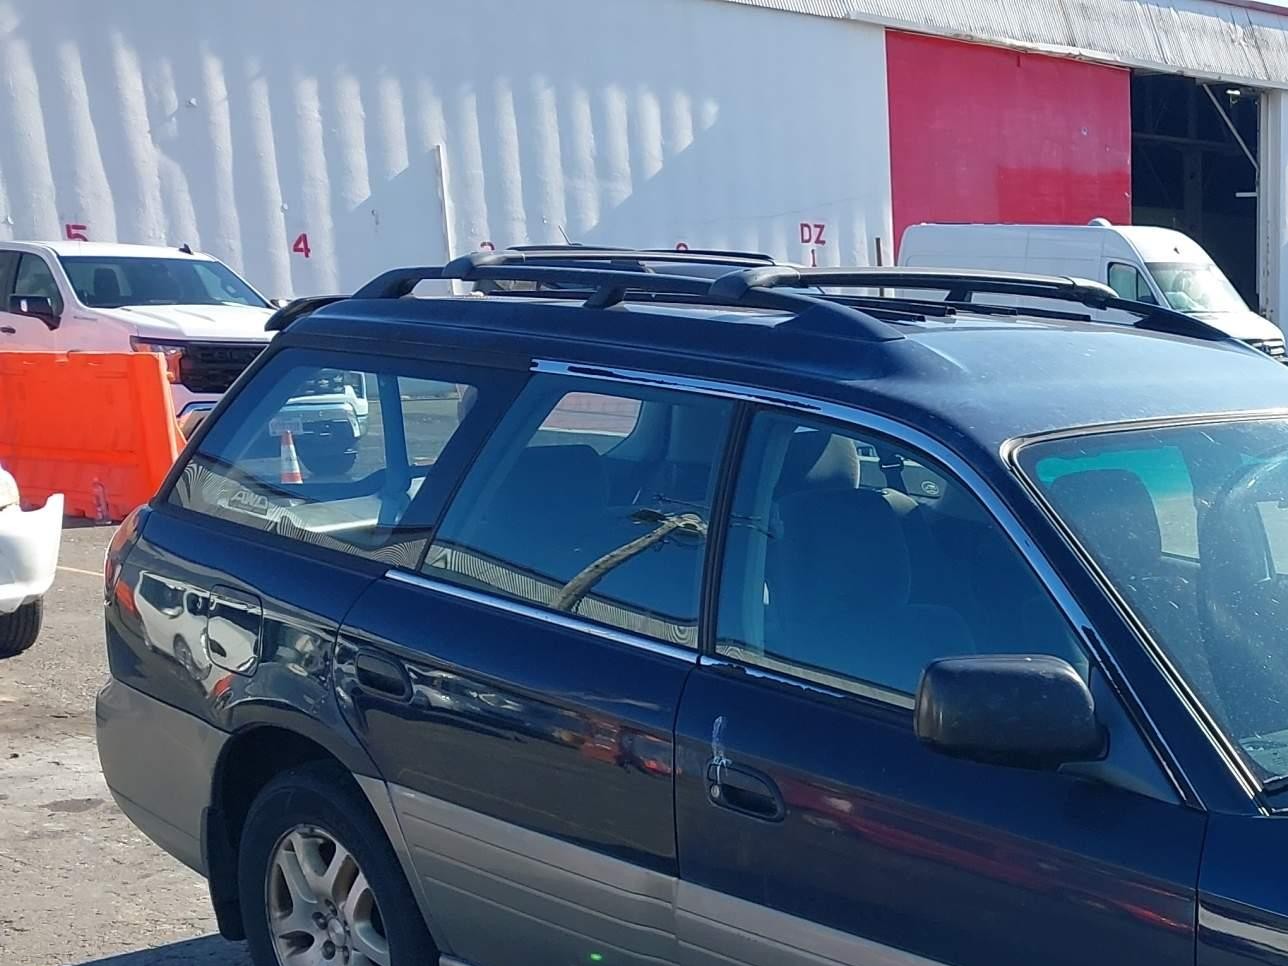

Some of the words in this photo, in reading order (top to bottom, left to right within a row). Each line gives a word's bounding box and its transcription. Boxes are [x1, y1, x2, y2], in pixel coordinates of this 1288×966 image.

[293, 233, 311, 258] 4
[800, 223, 826, 246] DZ
[230, 488, 269, 510] AWD
